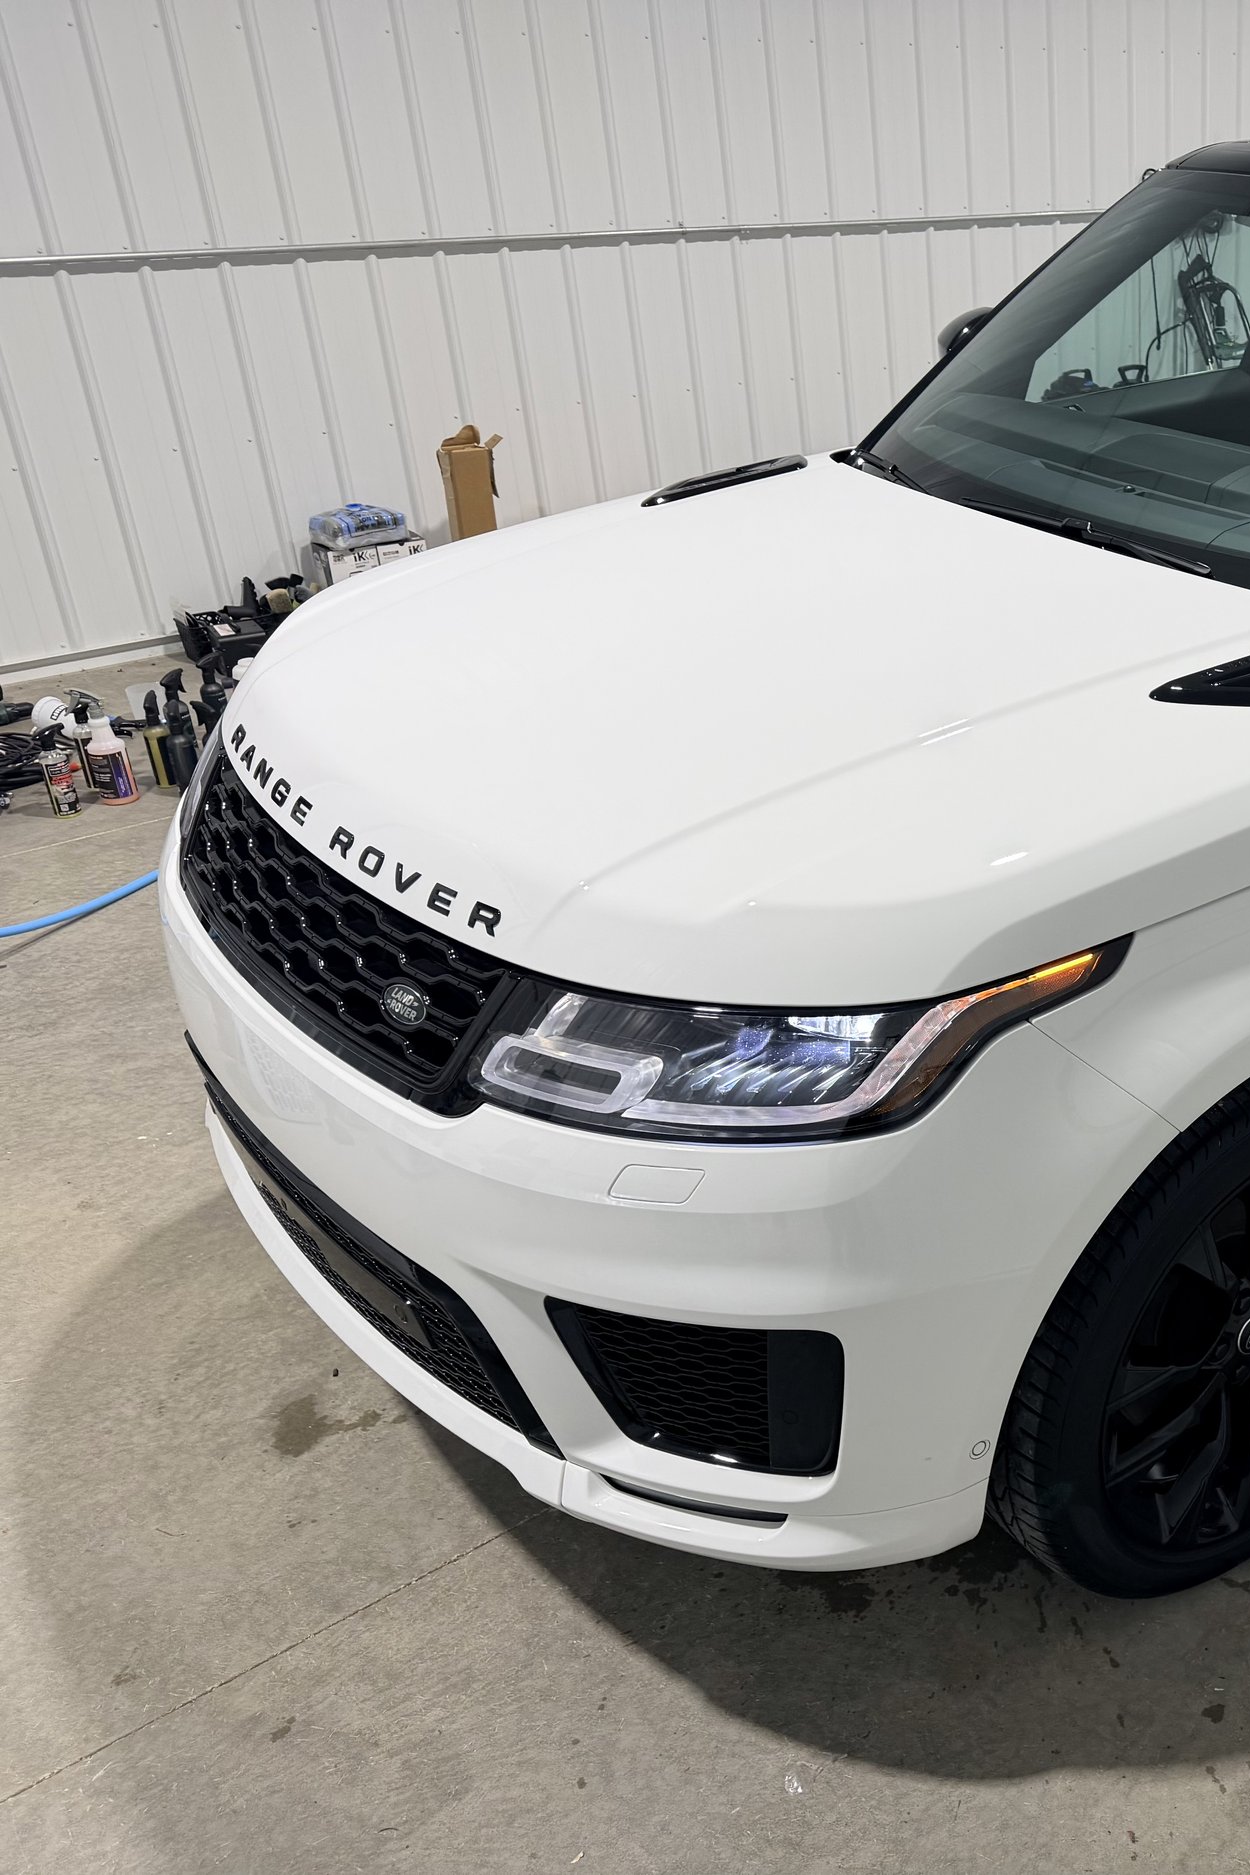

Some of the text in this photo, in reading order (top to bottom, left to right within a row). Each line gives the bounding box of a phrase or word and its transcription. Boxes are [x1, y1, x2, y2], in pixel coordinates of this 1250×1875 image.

[231, 723, 502, 938] RANGE ROVER
[391, 987, 415, 1006] LAND
[390, 999, 418, 1021] ROVER
